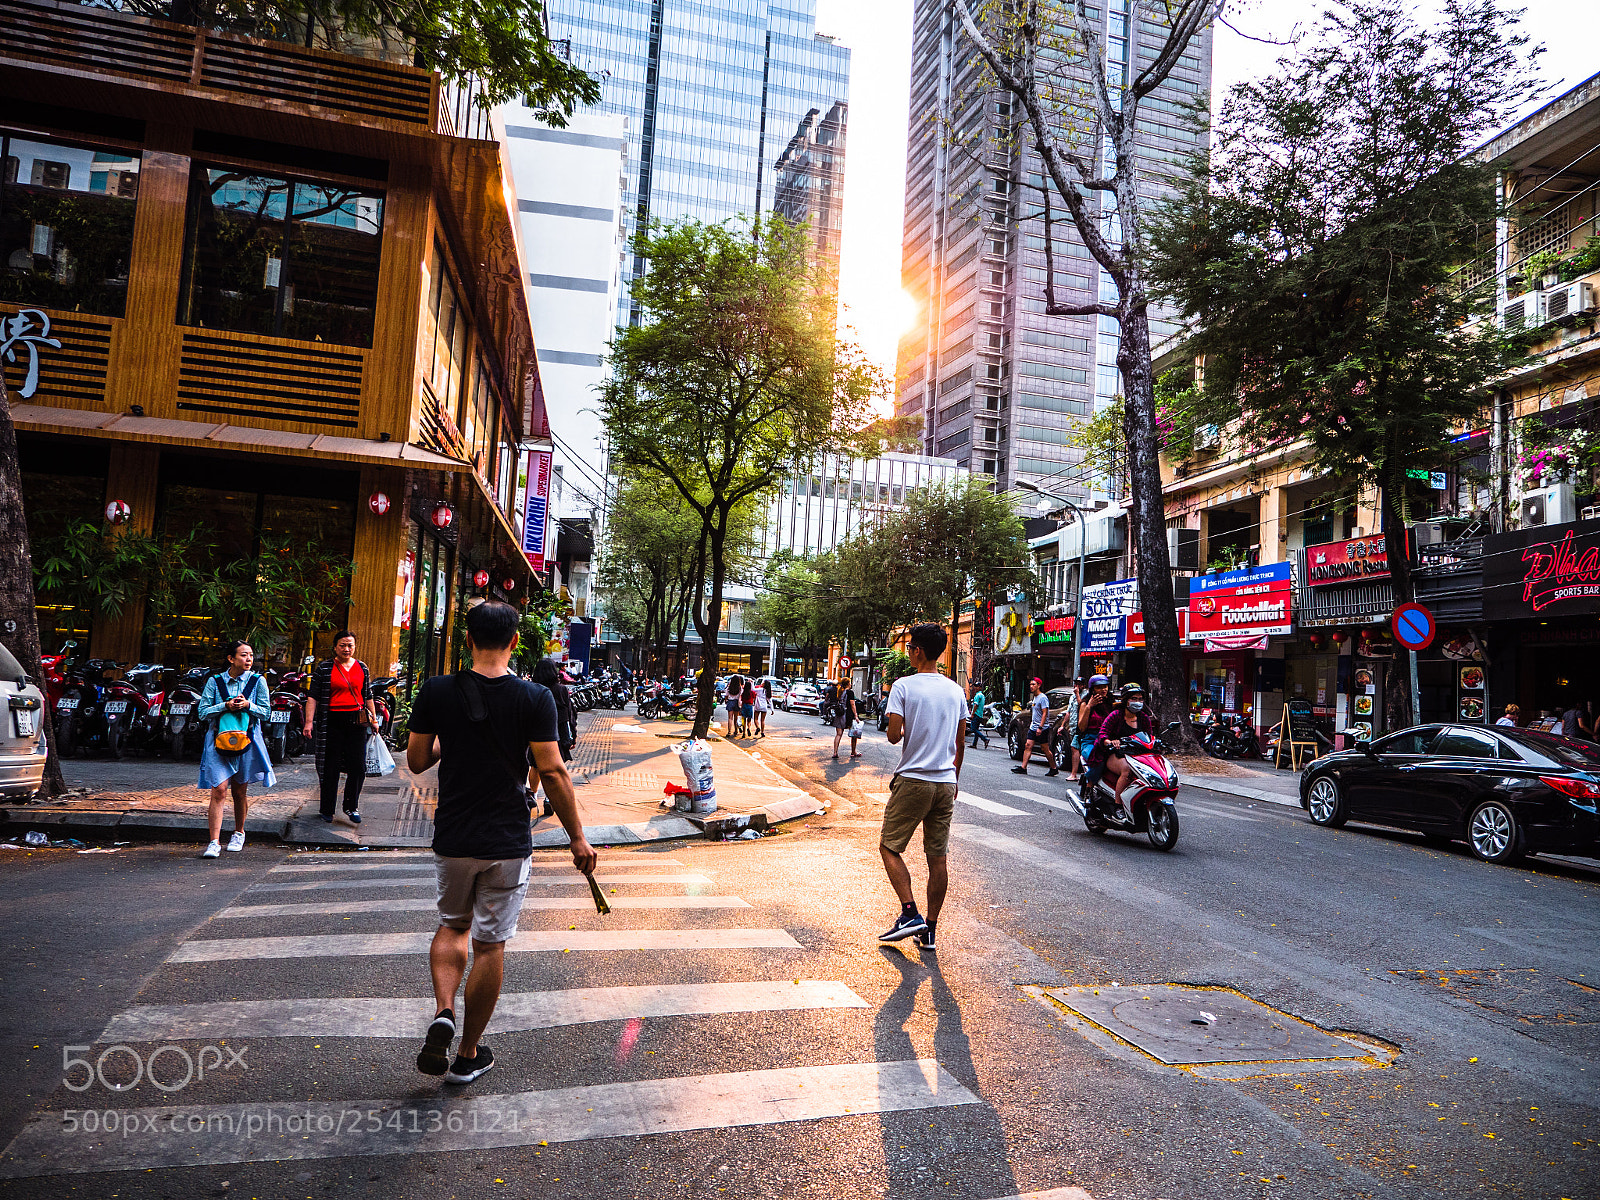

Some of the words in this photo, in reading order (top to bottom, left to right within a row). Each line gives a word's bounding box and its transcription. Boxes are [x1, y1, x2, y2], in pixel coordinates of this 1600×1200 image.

[537, 454, 550, 497] SUPERMARKET
[526, 496, 546, 553] AKURUHI
[1310, 560, 1361, 580] HONGKONG
[1554, 586, 1582, 599] SPORTS
[1584, 586, 1599, 595] BAR
[1086, 597, 1123, 617] SONY
[1222, 600, 1285, 624] FoodcoMart
